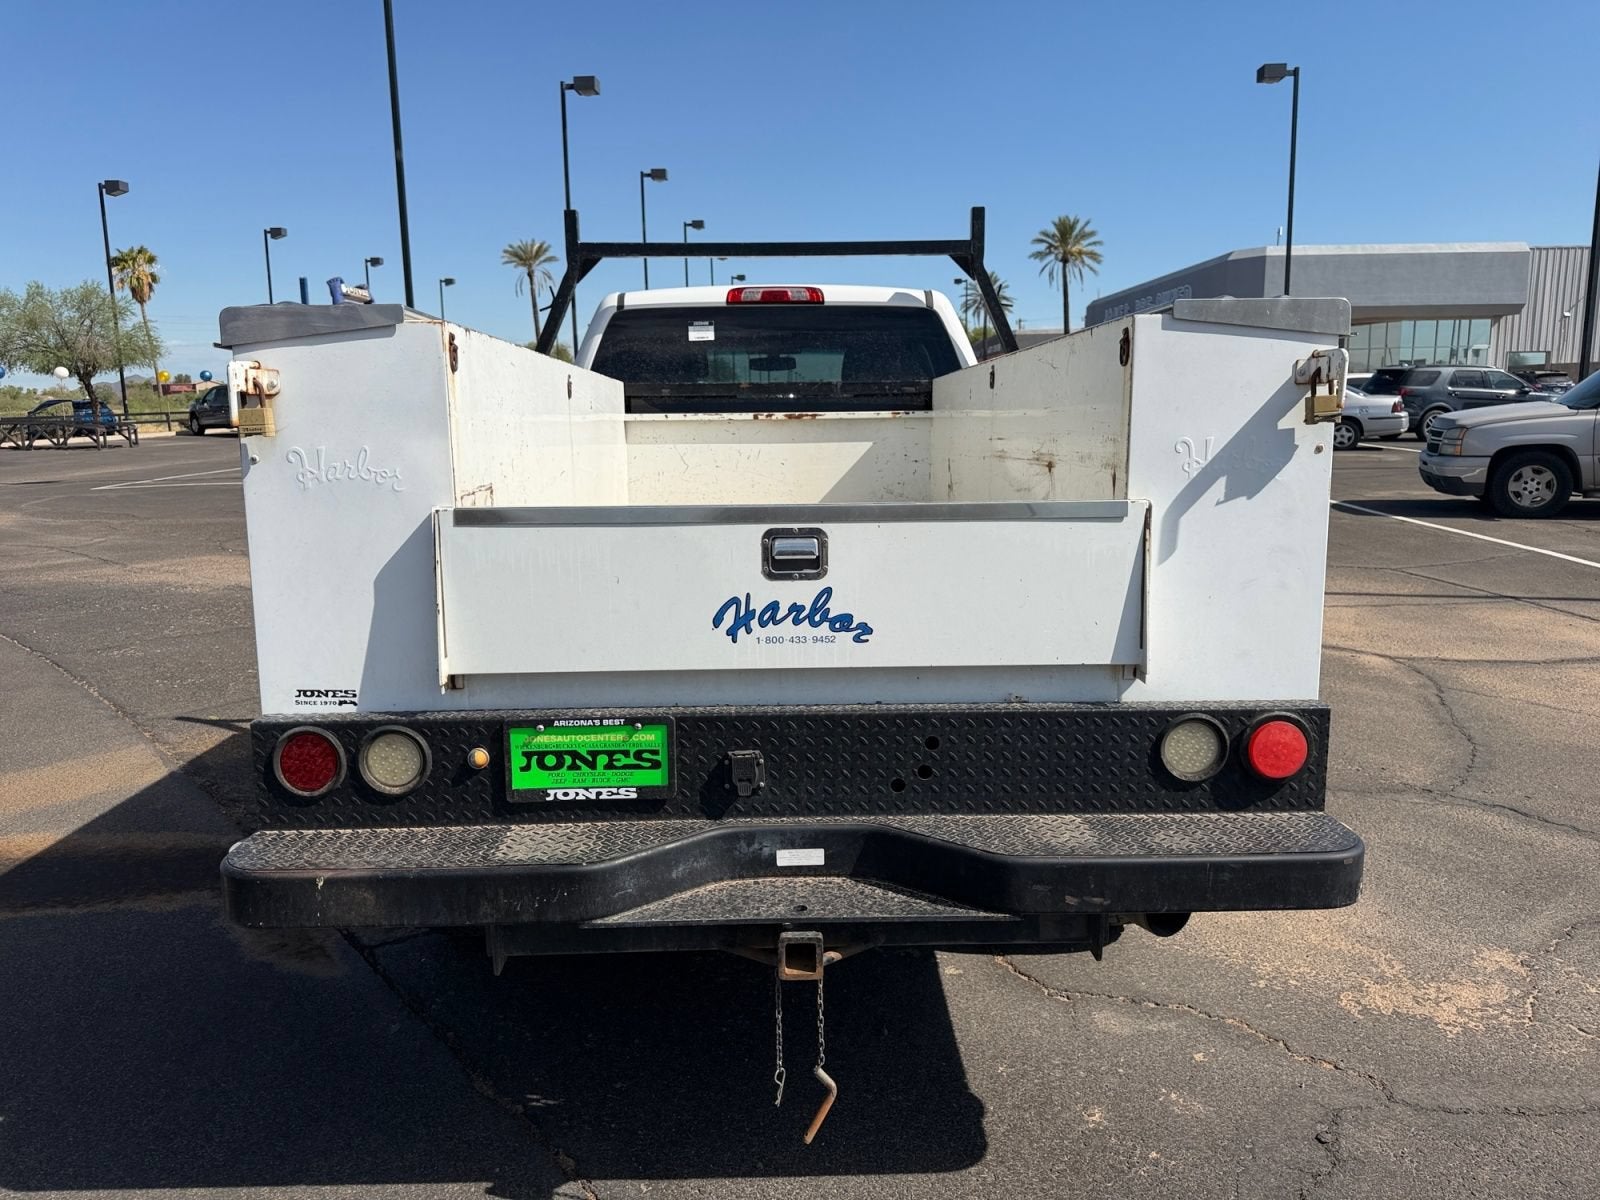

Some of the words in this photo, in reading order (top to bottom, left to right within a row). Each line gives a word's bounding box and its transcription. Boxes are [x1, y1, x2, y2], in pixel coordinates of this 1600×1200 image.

[286, 445, 406, 493] Harbor
[712, 586, 874, 644] Harbor
[294, 689, 358, 699] JONES
[553, 719, 601, 727] ARIZONA'S
[519, 749, 662, 773] JONES
[545, 787, 638, 801] JONES
